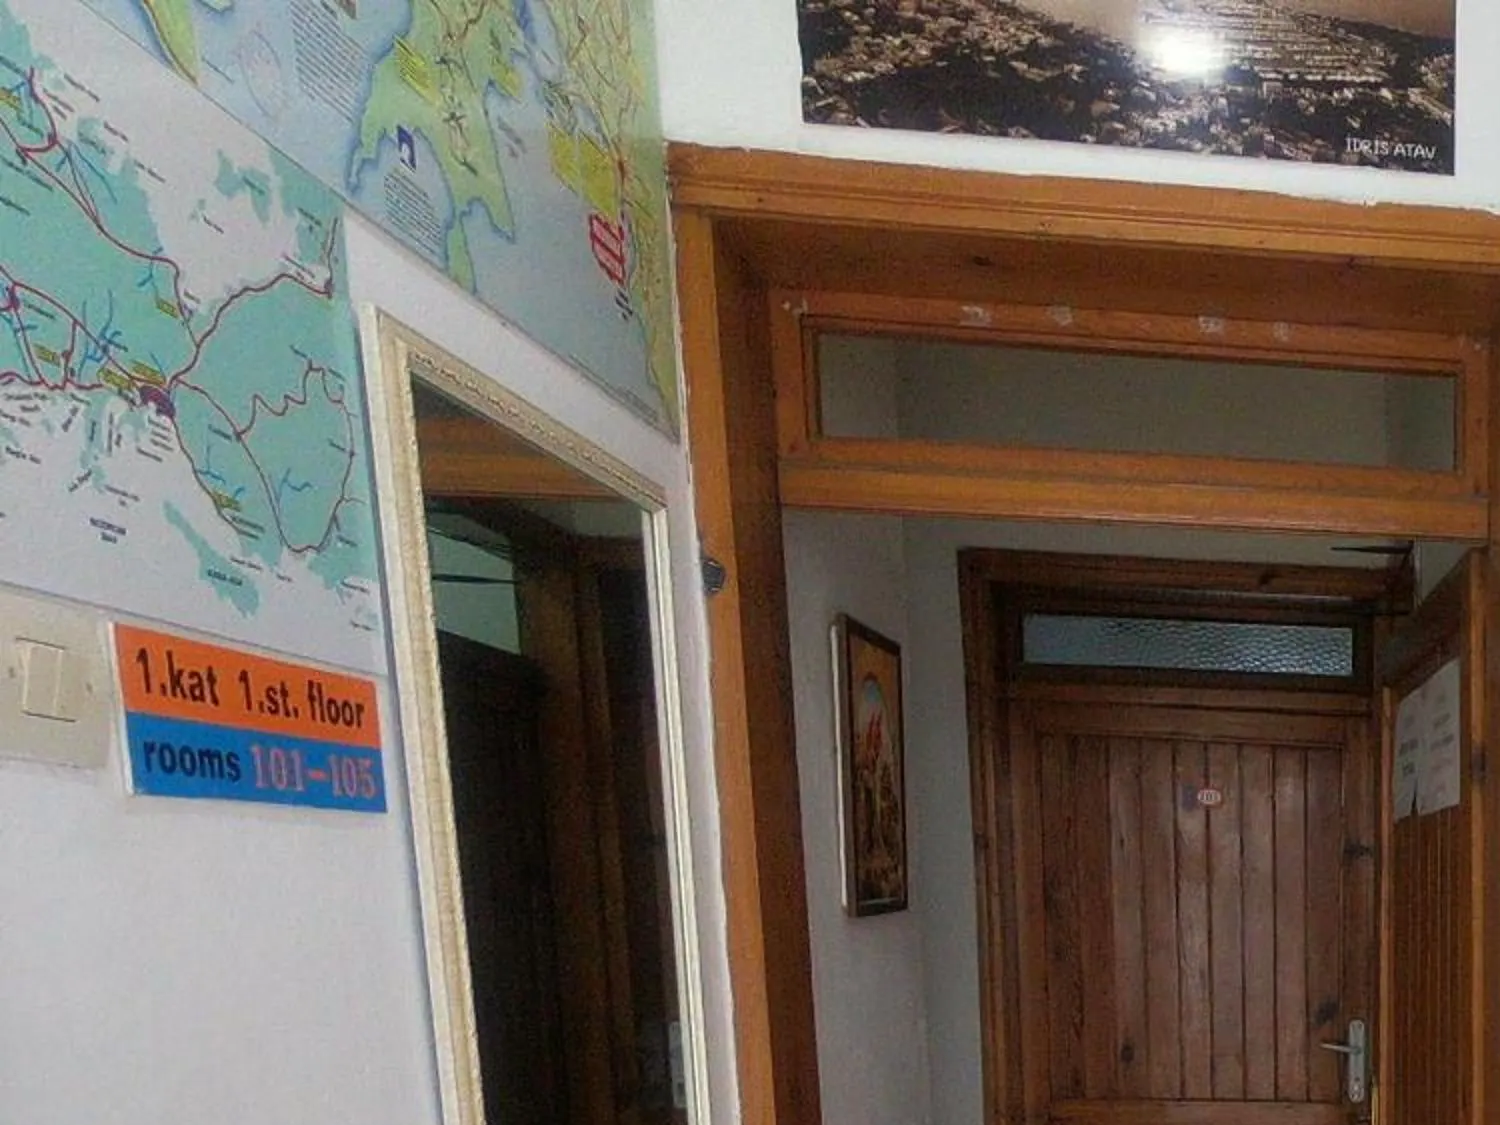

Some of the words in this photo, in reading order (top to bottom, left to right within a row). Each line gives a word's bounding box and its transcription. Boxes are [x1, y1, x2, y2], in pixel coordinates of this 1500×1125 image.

[1393, 143, 1437, 160] ATAV
[136, 648, 219, 707] 1.kat
[307, 680, 365, 728] floor
[143, 741, 241, 782] rooms
